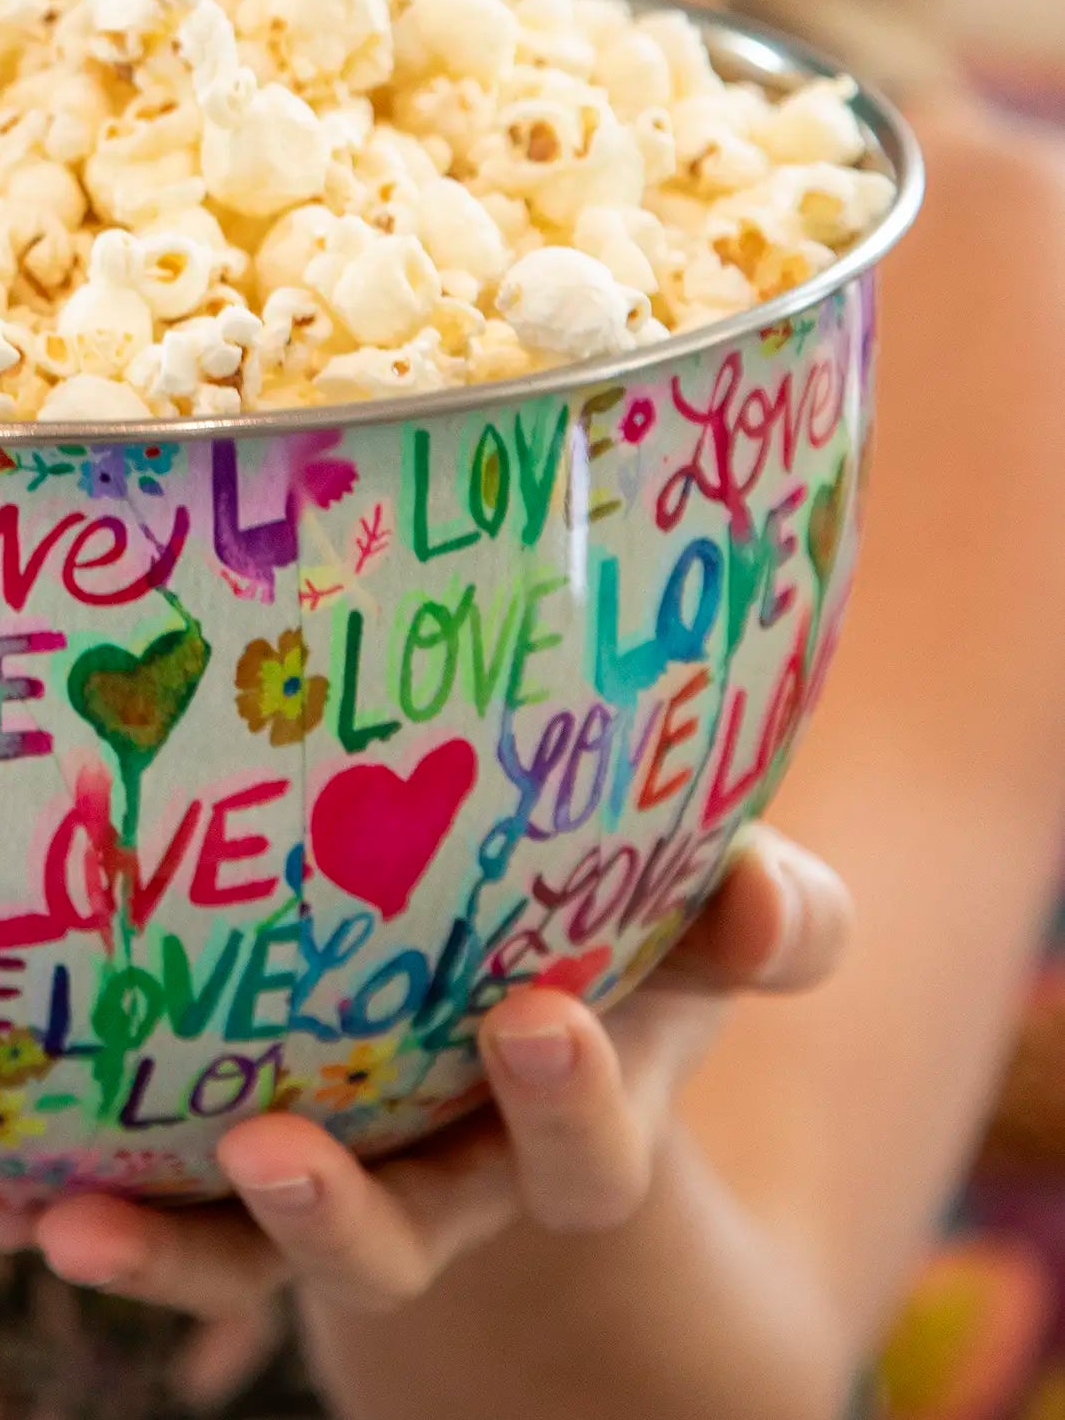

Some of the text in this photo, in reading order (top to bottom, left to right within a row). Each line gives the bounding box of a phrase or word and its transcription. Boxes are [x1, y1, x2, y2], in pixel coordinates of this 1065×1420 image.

[405, 386, 625, 563] LOVE
[656, 349, 843, 535] Love
[338, 580, 570, 753] LOVE
[592, 483, 807, 703] LOVE
[497, 668, 711, 842] LOVE
[43, 920, 300, 1059] LOVE
